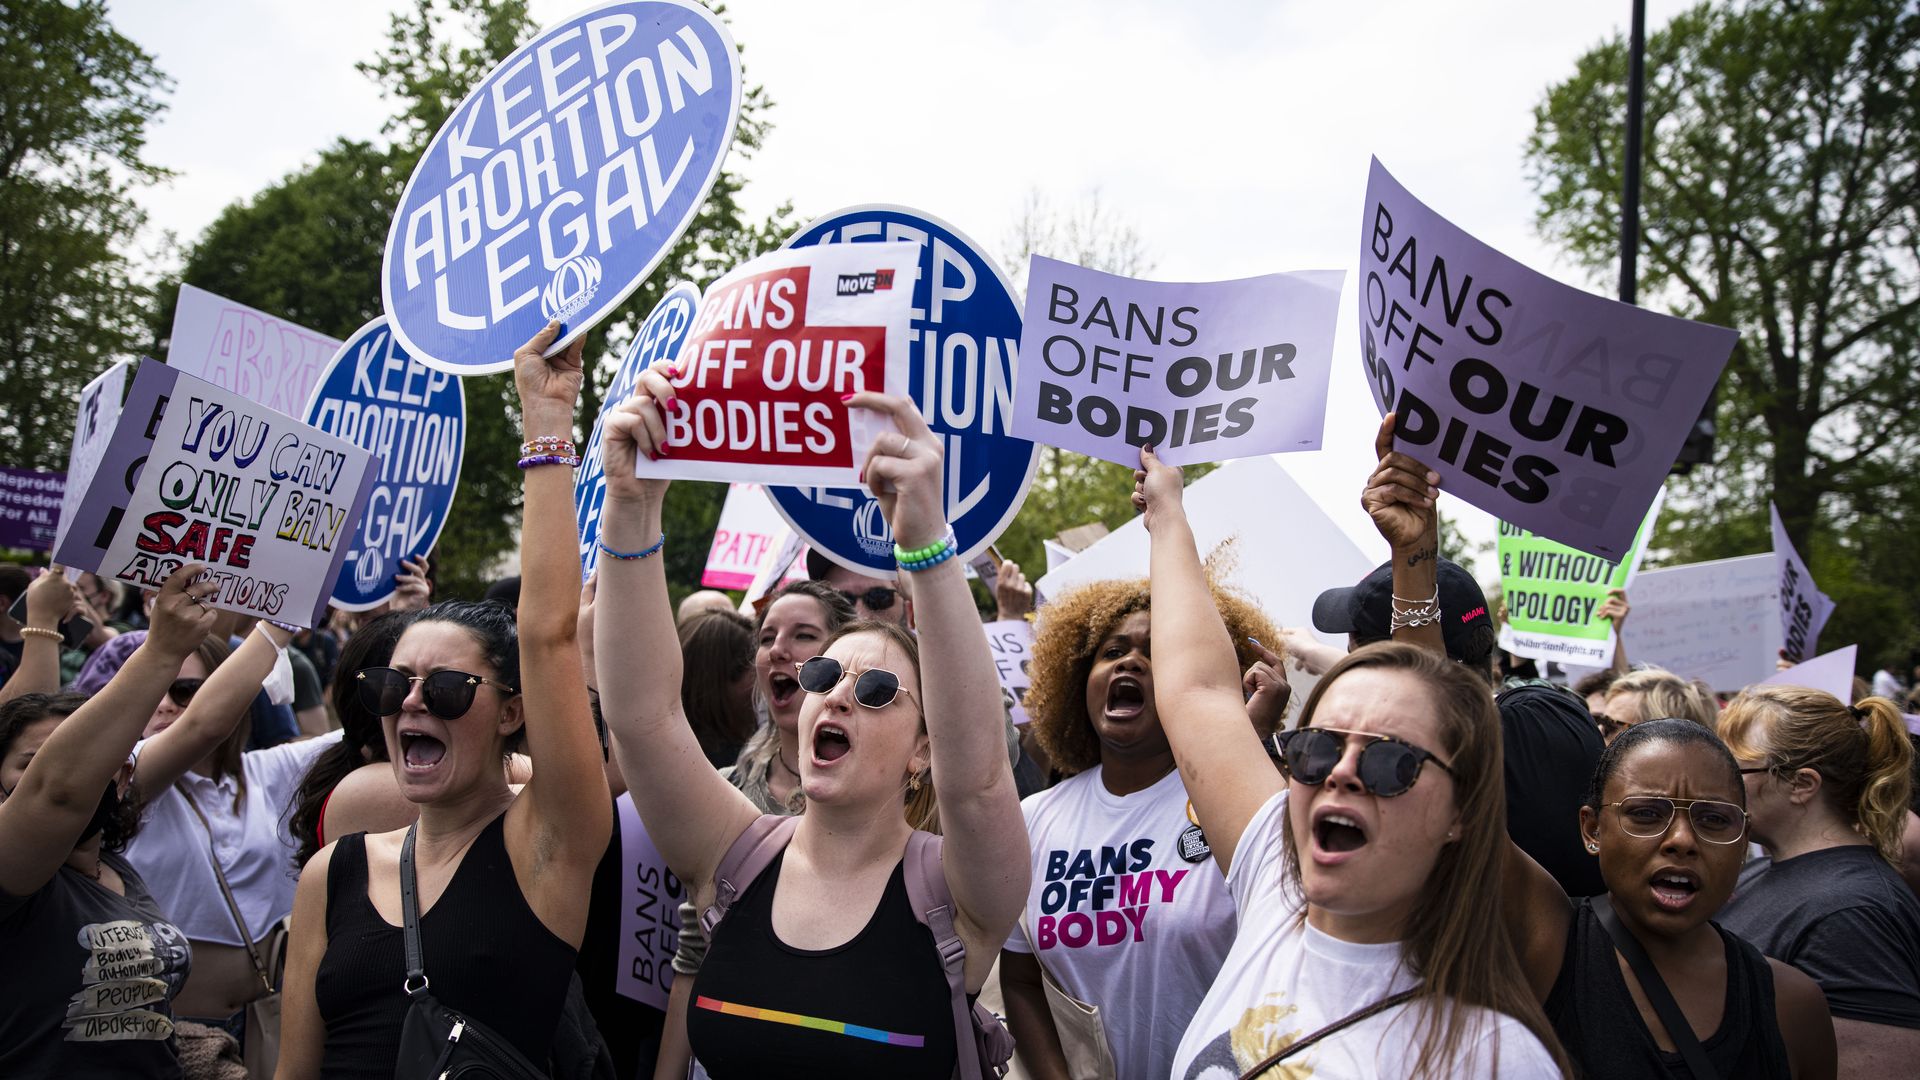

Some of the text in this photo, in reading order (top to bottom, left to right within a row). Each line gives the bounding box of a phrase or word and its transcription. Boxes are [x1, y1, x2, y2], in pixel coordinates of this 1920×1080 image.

[448, 14, 637, 178] KEEP
[404, 25, 713, 291] ABORTION
[435, 134, 694, 330] LEGAL
[541, 256, 602, 319] NOW
[1372, 202, 1512, 346] BANS
[693, 277, 797, 338] BANS
[1048, 283, 1199, 347] BANS
[203, 309, 340, 418] ABORT
[351, 331, 449, 408] KEEP
[670, 339, 752, 390] OFF
[762, 339, 866, 393] OUR
[1043, 335, 1153, 393] OFF
[1166, 343, 1297, 398] OUR
[1367, 271, 1628, 469] OFF OUR
[666, 399, 836, 455] BODIES
[1037, 381, 1258, 449] BODIES
[1366, 320, 1560, 504] BODIES
[182, 397, 269, 469] YOU
[270, 433, 346, 495] CAN
[159, 461, 280, 531] ONLY
[276, 491, 346, 552] BAN
[345, 487, 433, 560] GAL
[853, 499, 895, 543] NO
[136, 511, 256, 569] SAFE
[1503, 551, 1619, 585] & WITHOUT
[116, 552, 289, 616] ABRTIONS
[1461, 606, 1486, 624] MIAMI
[1508, 590, 1597, 625] APOLOGY
[1784, 593, 1813, 664] ODIES
[1040, 869, 1189, 915] OFF MY
[1045, 838, 1155, 882] BANS
[632, 862, 660, 985] BANS
[1038, 905, 1150, 950] BODY
